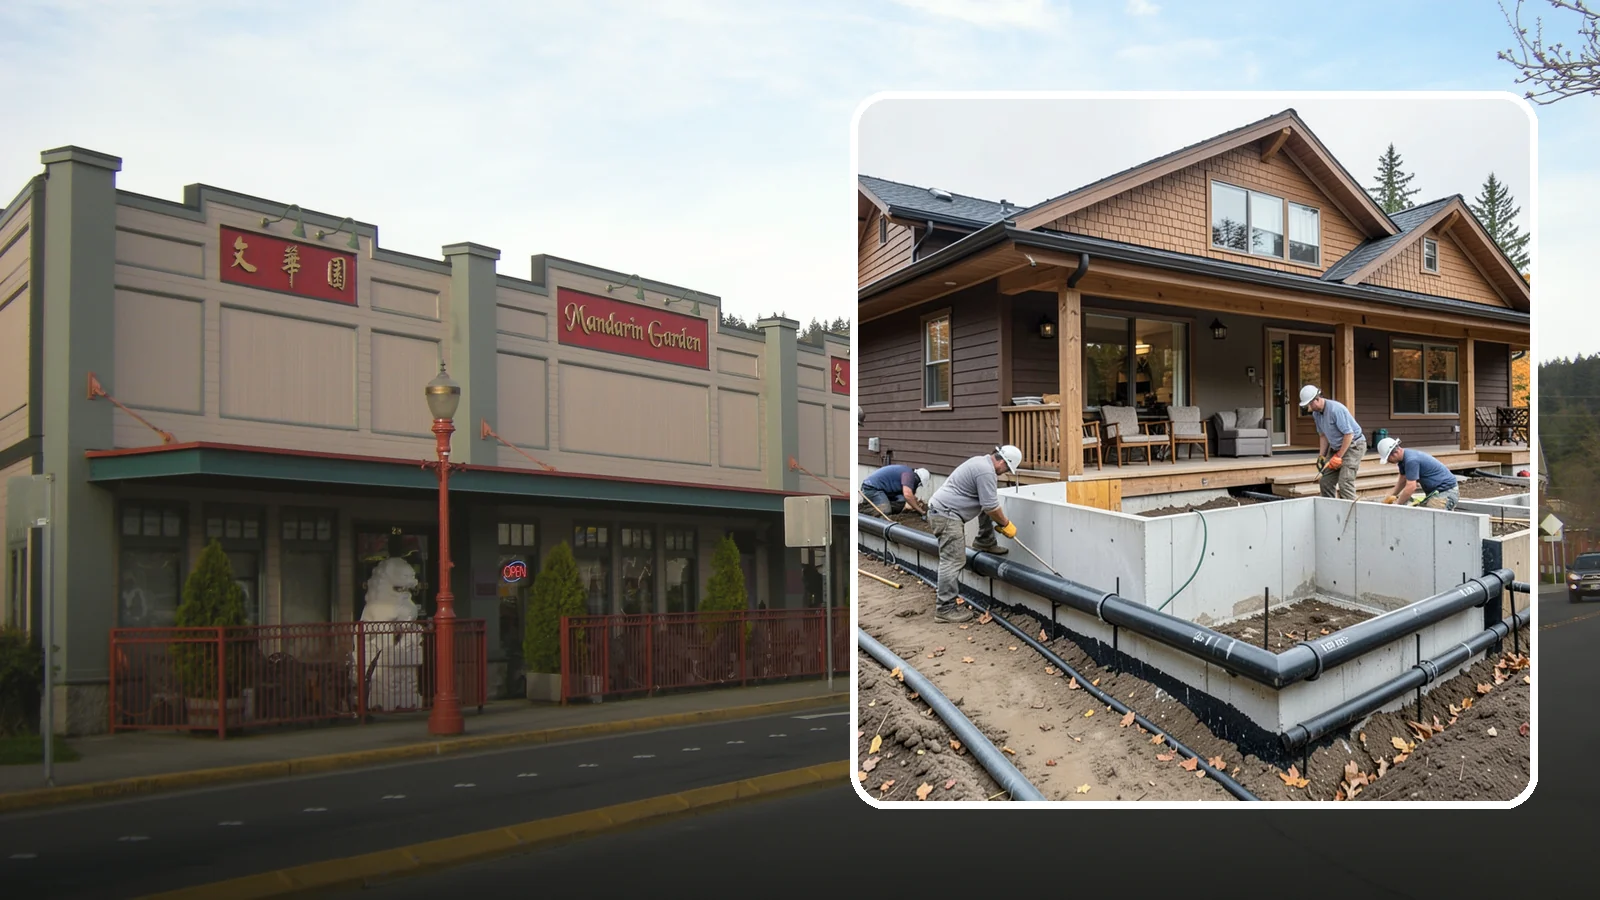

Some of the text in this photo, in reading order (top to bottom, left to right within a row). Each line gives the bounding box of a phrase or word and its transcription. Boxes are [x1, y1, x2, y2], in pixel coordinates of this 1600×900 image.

[231, 236, 346, 290] 文華園
[564, 302, 701, 352] Mandarin Garden
[503, 565, 527, 578] OPEN
